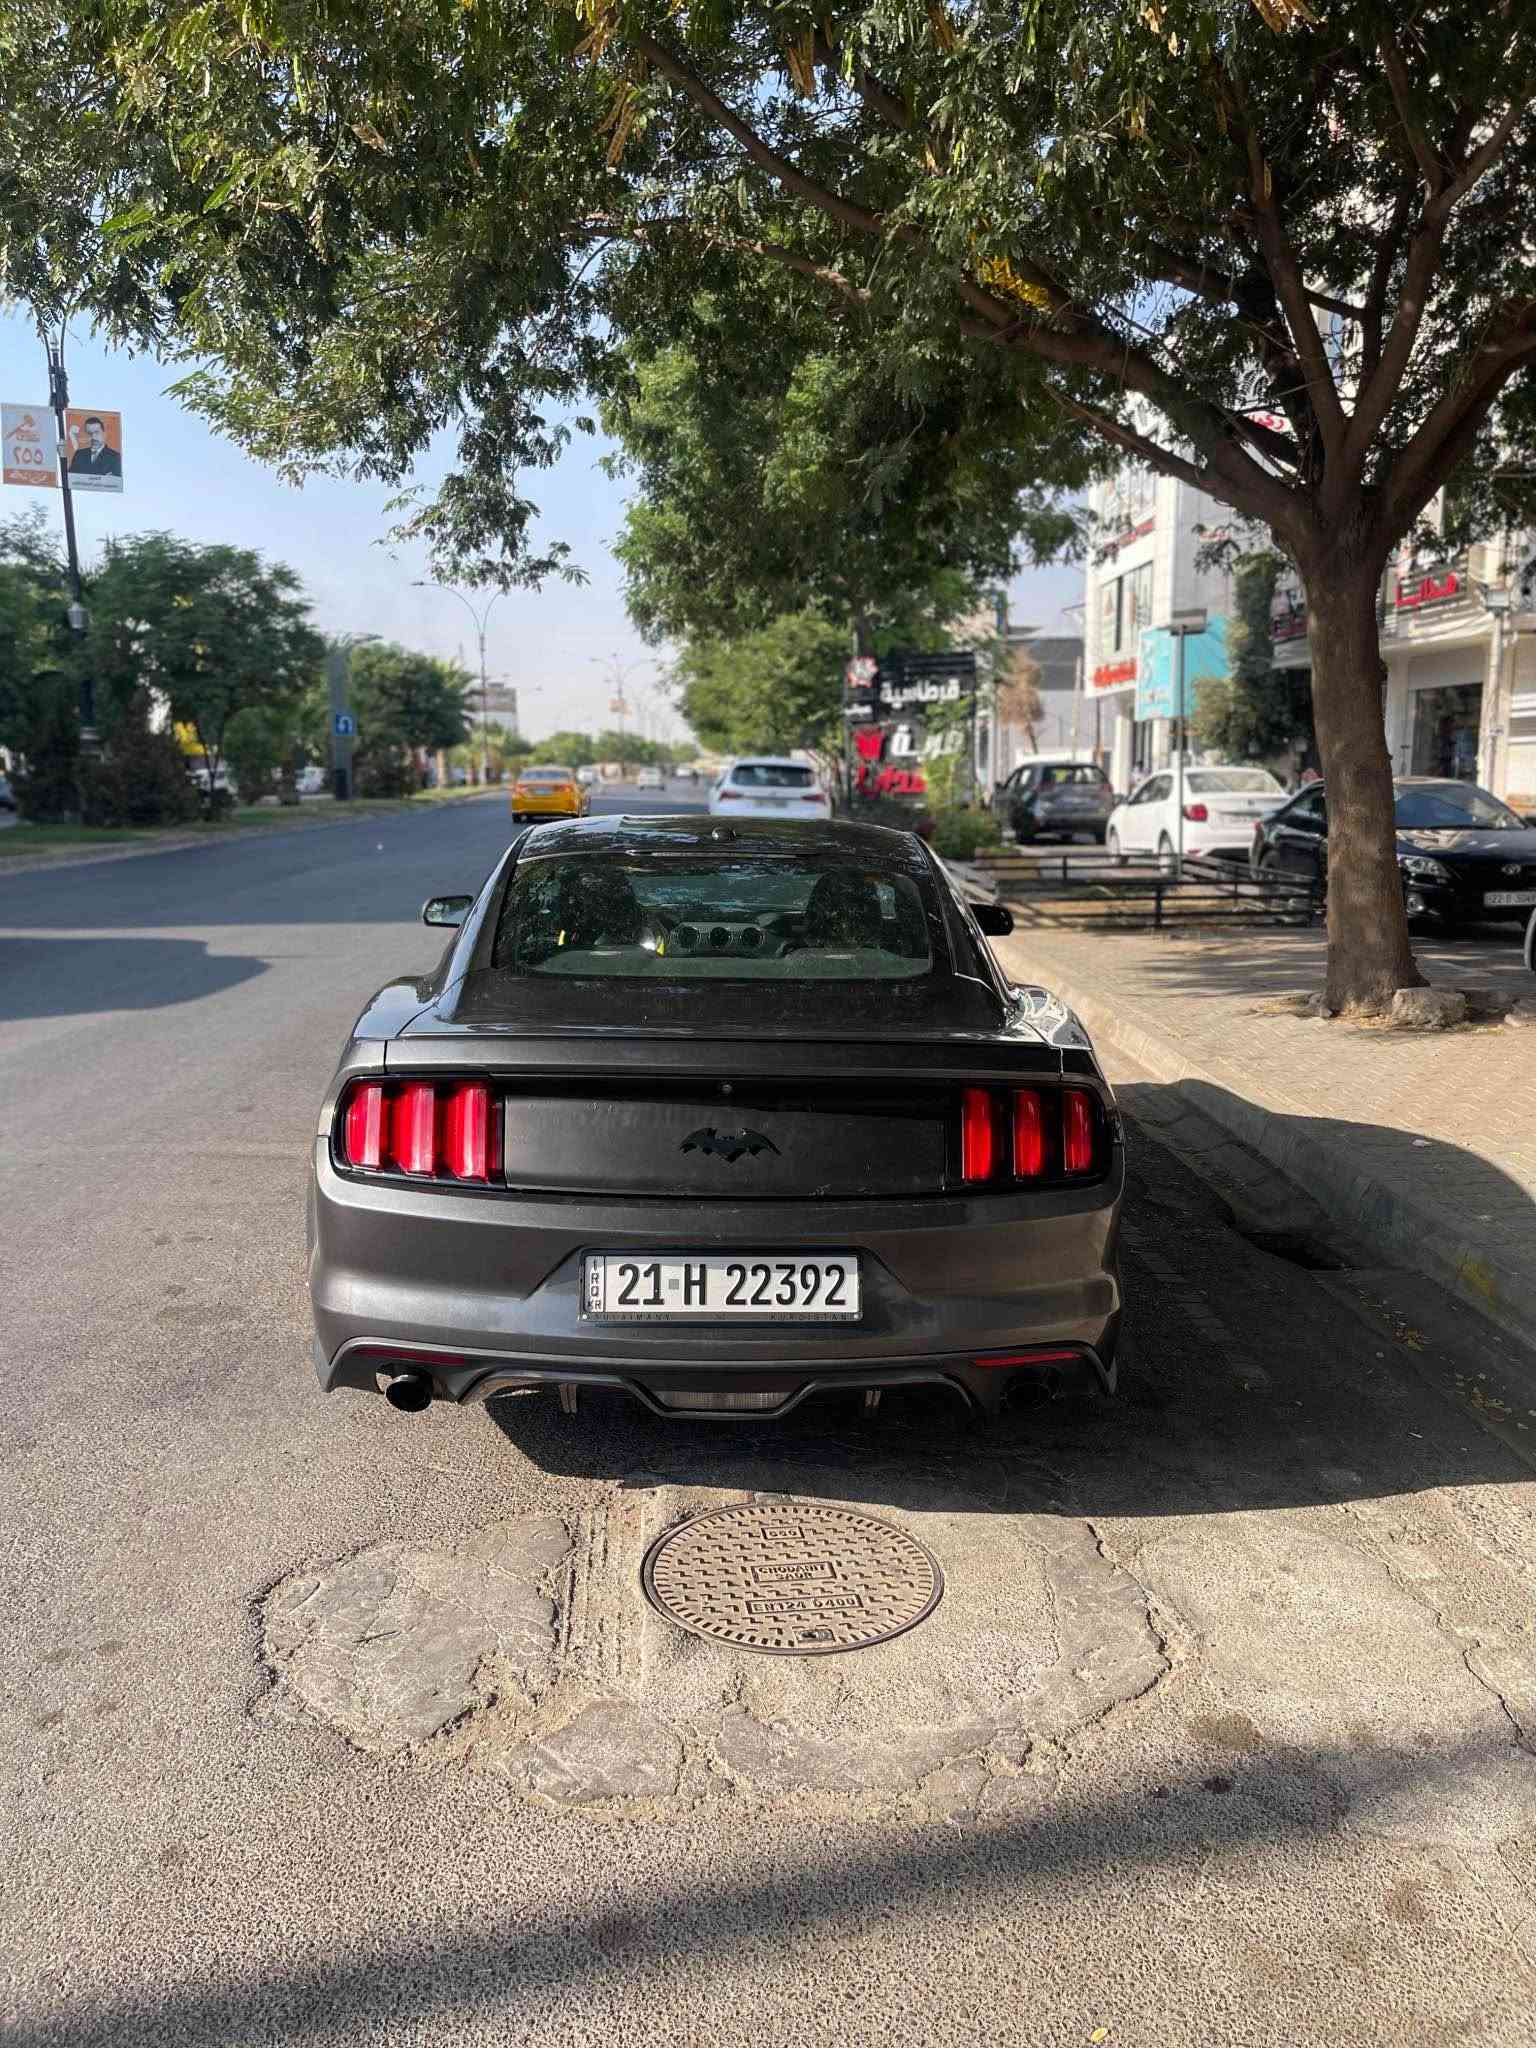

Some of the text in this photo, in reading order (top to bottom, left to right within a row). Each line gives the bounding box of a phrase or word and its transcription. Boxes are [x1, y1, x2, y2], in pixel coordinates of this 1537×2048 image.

[880, 678, 960, 710] قرطاسية
[617, 1263, 847, 1306] 21 H 22392
